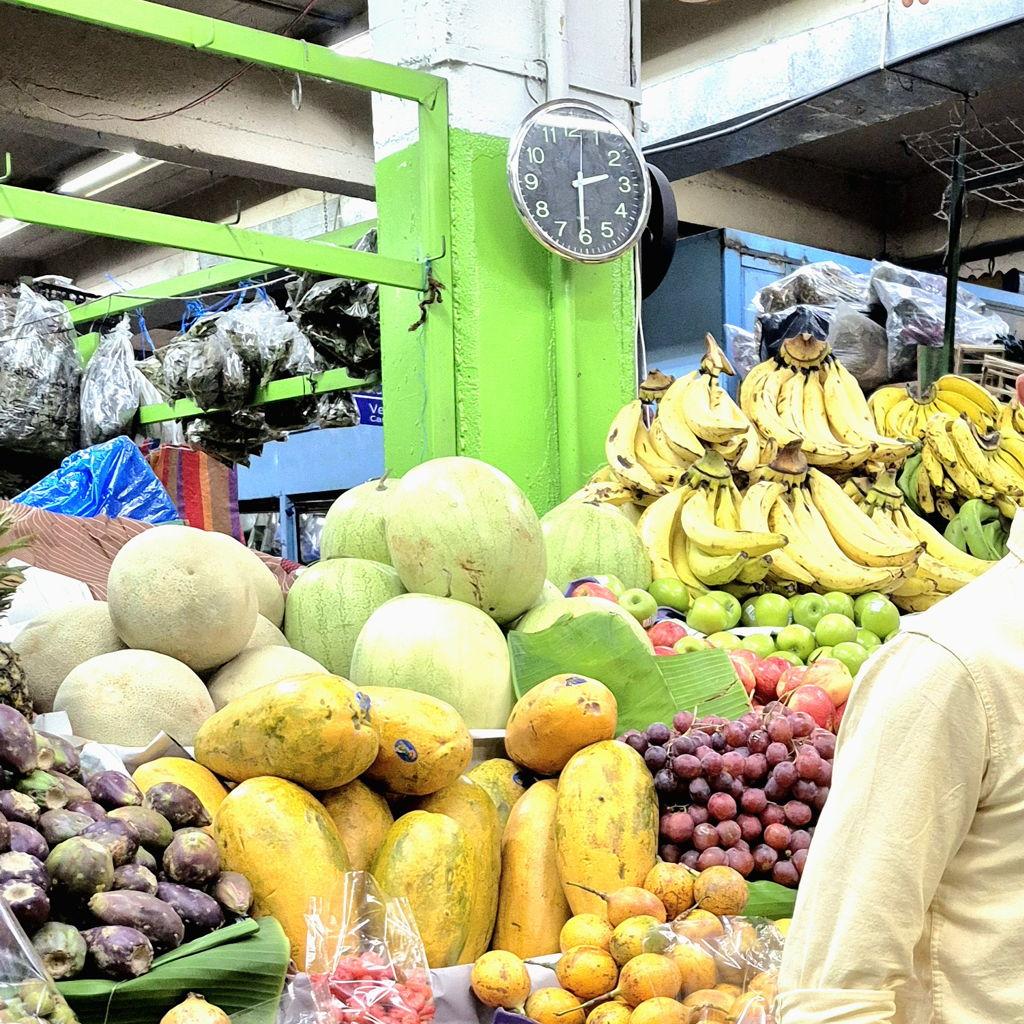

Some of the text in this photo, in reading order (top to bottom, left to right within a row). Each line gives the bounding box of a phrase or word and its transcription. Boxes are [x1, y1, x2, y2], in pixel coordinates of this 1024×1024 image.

[542, 126, 557, 144] 11
[526, 147, 545, 165] 10
[607, 150, 622, 167] 2
[524, 173, 539, 191] 9
[618, 176, 631, 193] 3
[535, 200, 550, 218] 8
[614, 202, 628, 218] 4
[554, 221, 567, 237] 7
[579, 228, 593, 245] 6
[600, 221, 614, 238] 5
